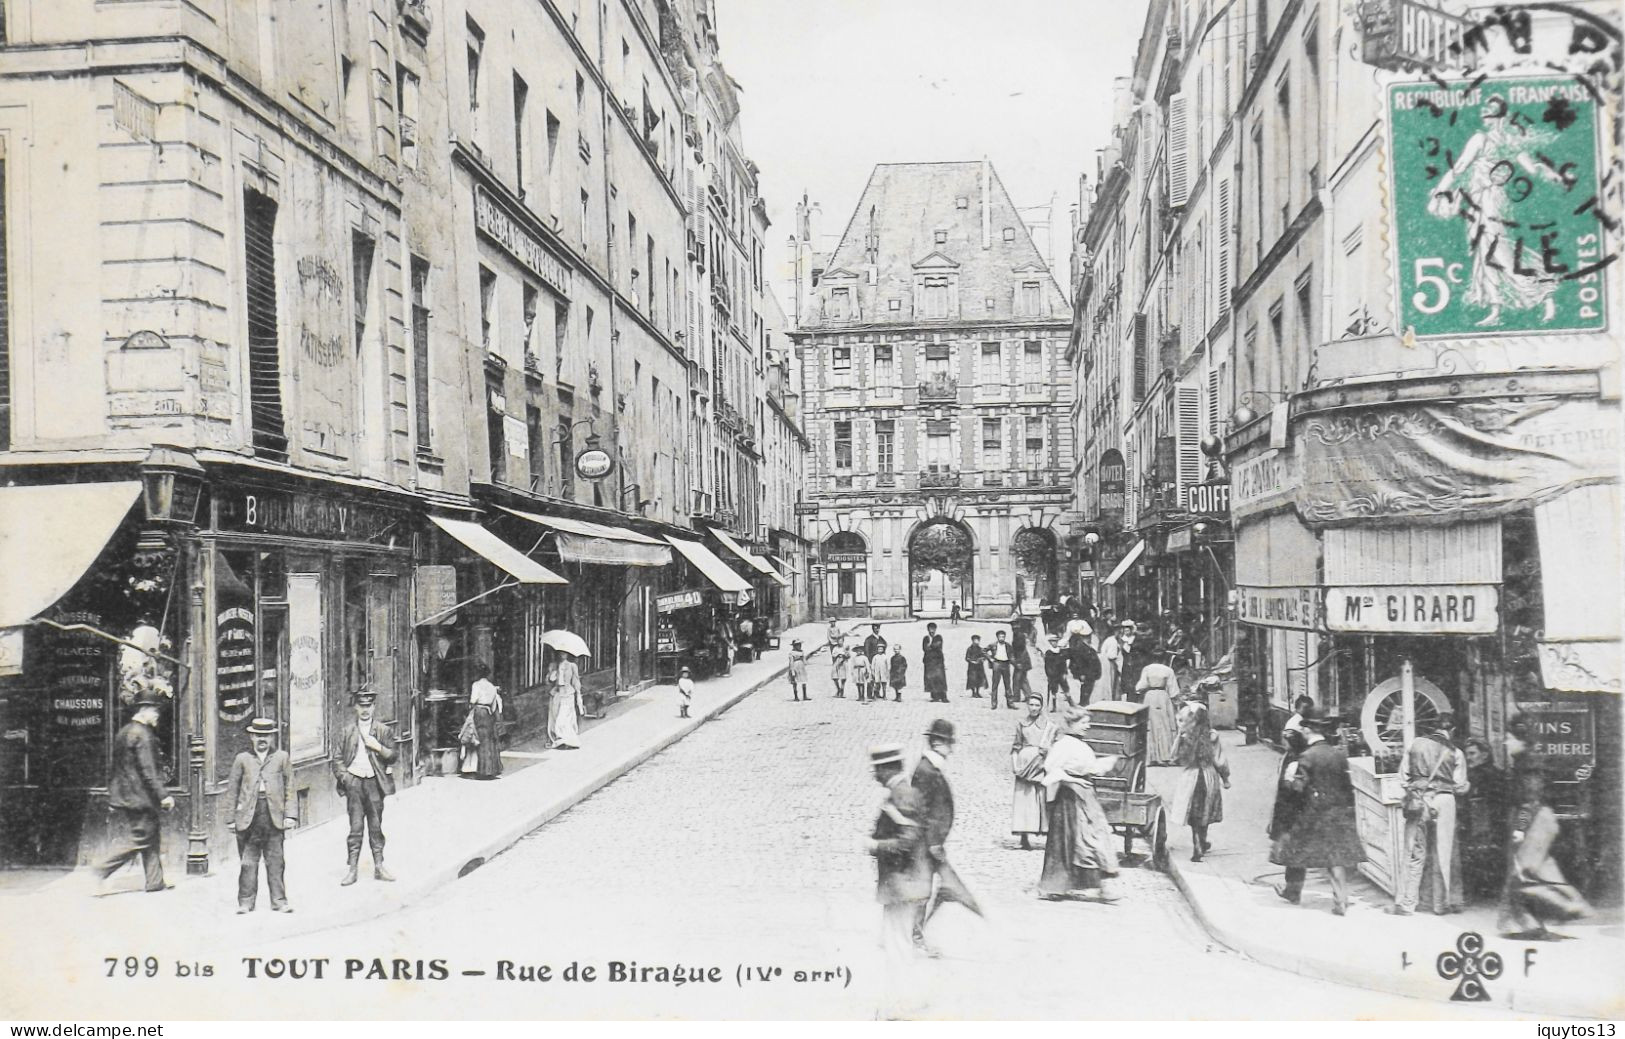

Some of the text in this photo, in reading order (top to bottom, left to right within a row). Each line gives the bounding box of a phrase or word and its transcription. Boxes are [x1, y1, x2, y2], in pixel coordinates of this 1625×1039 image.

[1402, 3, 1466, 69] HOTEL
[1577, 232, 1599, 319] POSTES
[1188, 484, 1232, 513] COIFF
[1386, 595, 1475, 622] GIRARD
[54, 698, 103, 710] CHAUSSONS
[104, 956, 159, 978] 799
[175, 960, 214, 977] bis
[242, 958, 330, 979] TOUT
[345, 959, 449, 981] PARIS
[496, 960, 552, 983] Rue
[563, 961, 597, 983] de
[608, 960, 723, 988] Birague
